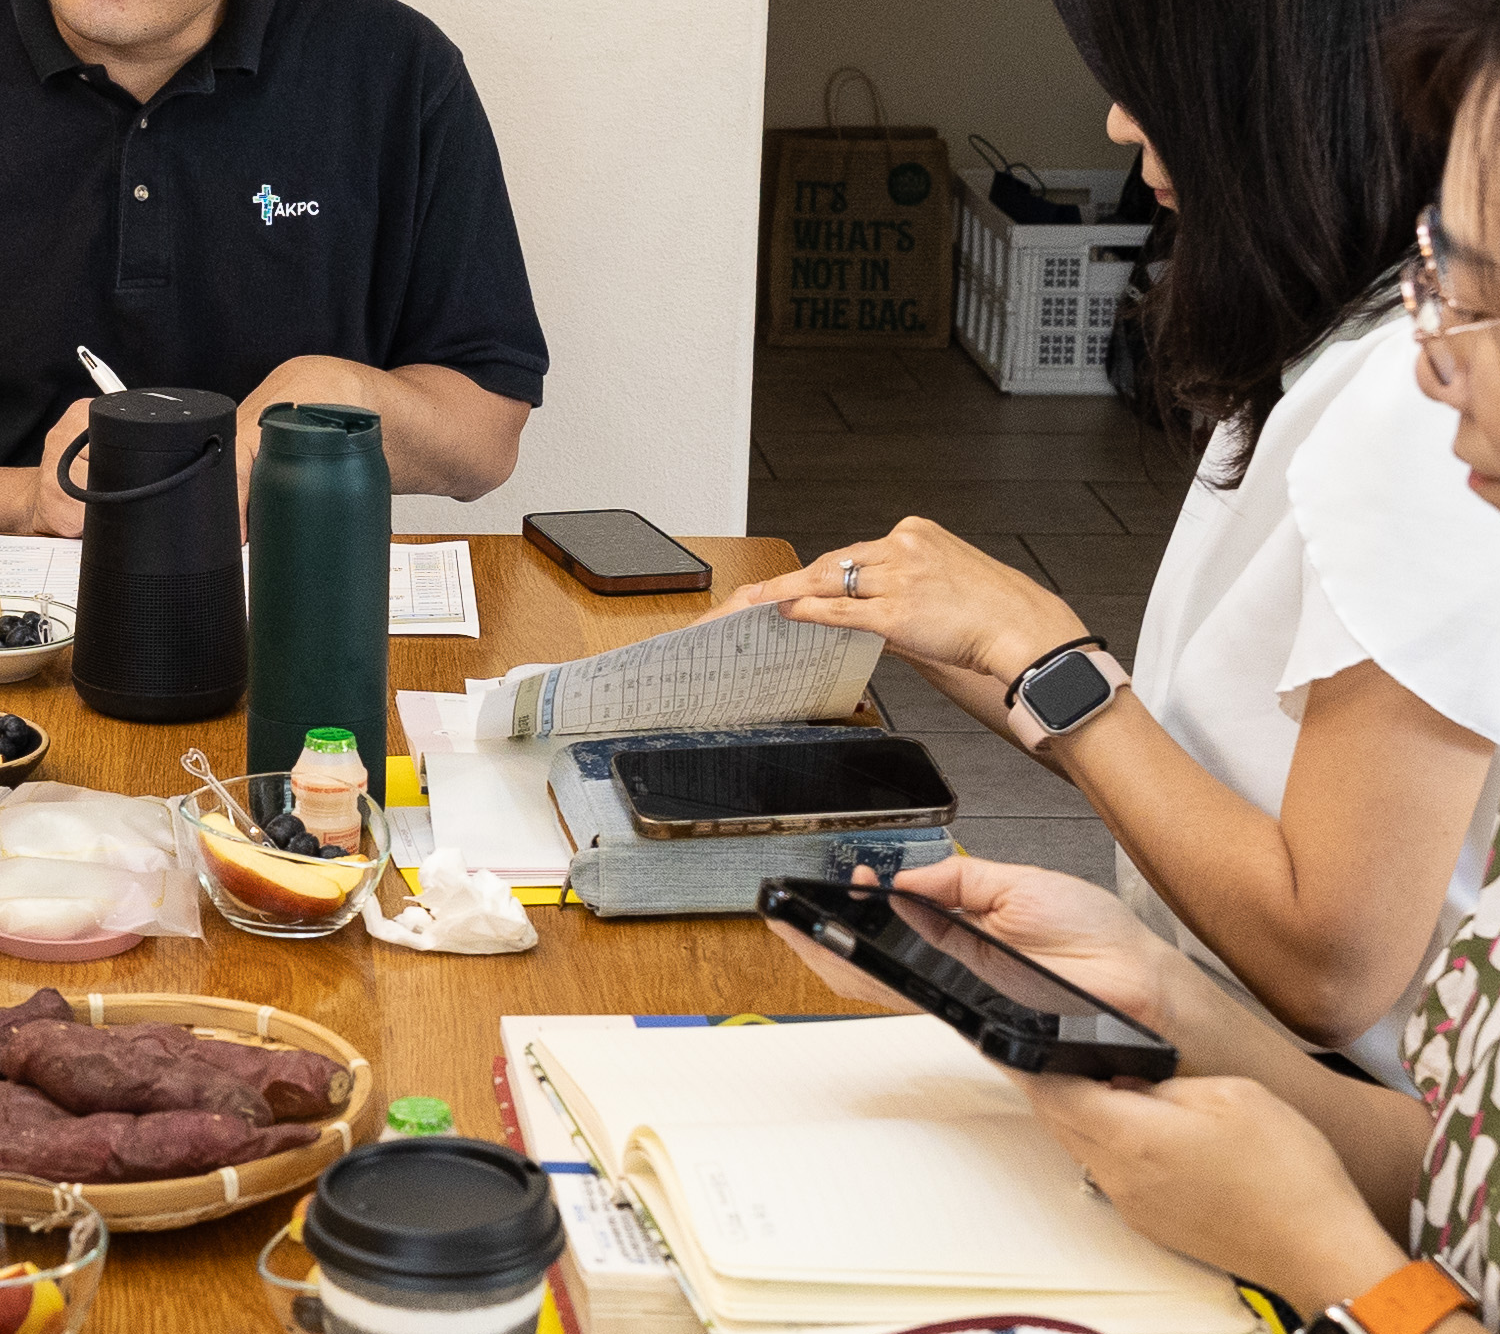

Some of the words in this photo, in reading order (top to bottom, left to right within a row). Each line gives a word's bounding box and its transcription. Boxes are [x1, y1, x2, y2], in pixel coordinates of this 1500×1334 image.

[274, 201, 320, 217] AKPC
[793, 180, 849, 213] IT'S
[793, 220, 916, 254] WHAT'S
[789, 257, 855, 291] NOT
[859, 259, 891, 290] IN
[788, 296, 850, 331] THE
